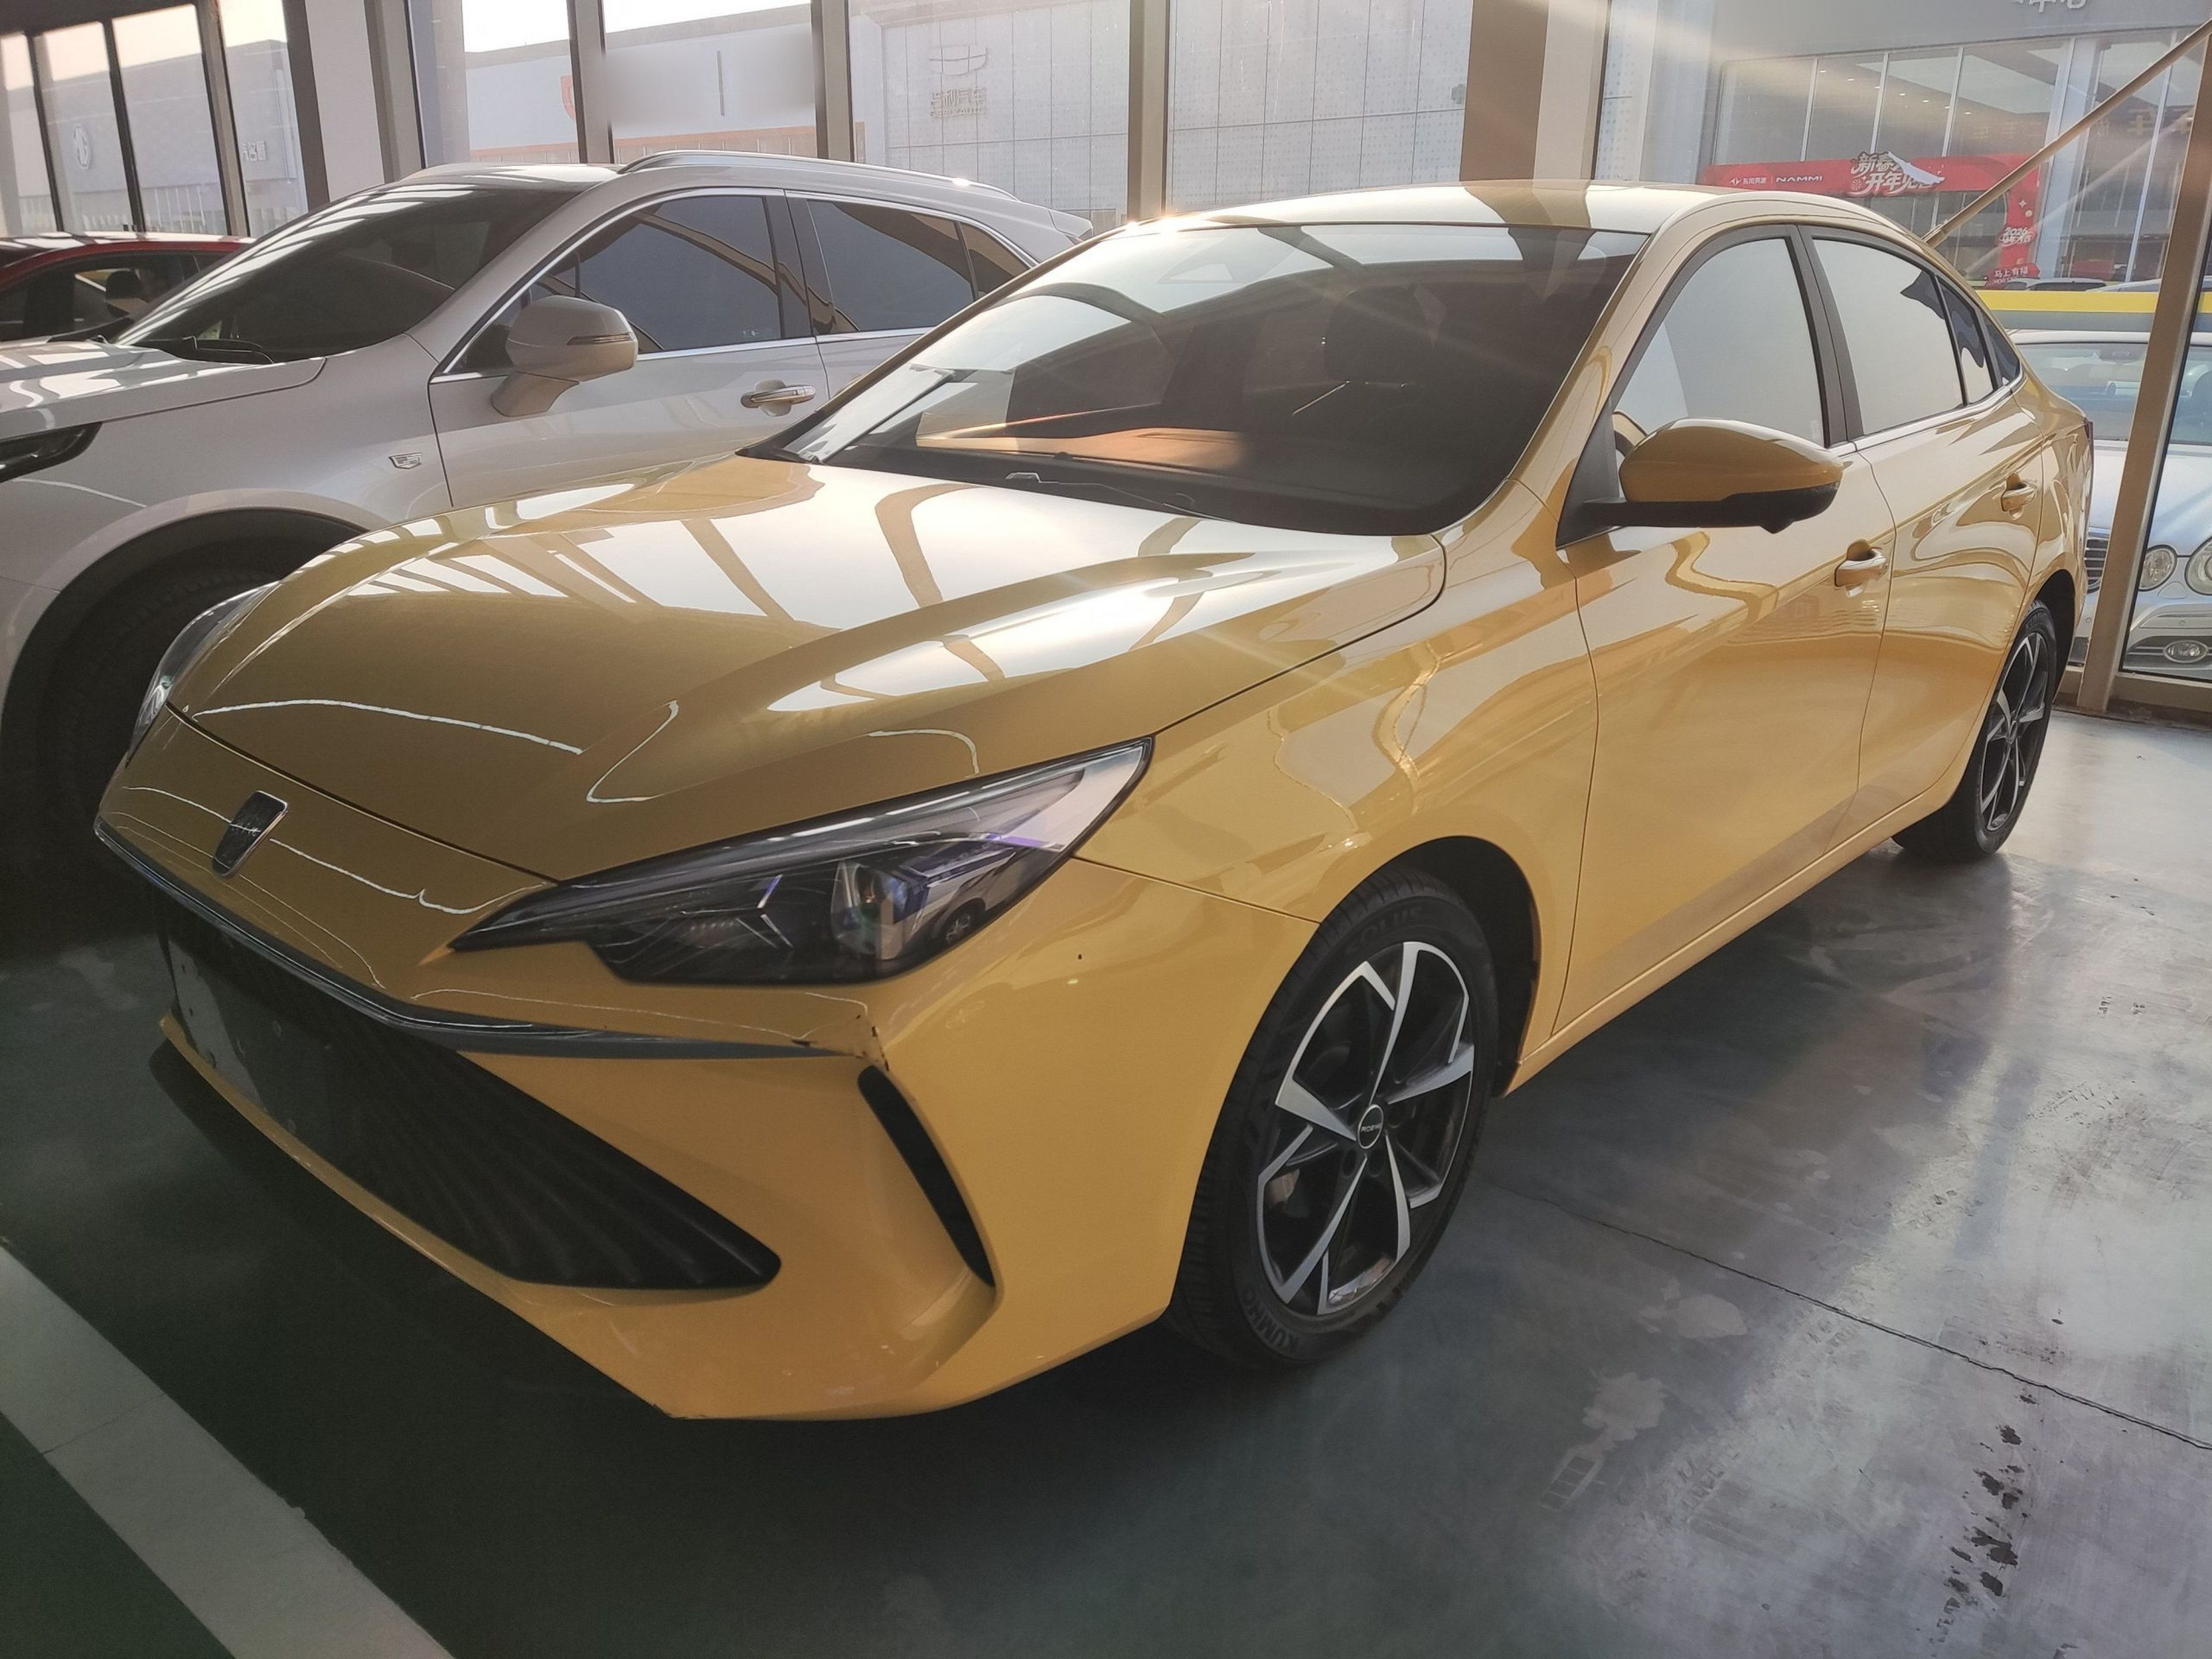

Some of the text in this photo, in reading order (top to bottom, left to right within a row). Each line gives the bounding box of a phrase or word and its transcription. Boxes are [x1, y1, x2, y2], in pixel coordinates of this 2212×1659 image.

[2004, 226, 2028, 236] 2026
[1994, 266, 2028, 278] 马上有福
[1242, 1284, 1300, 1354] KUMHO
